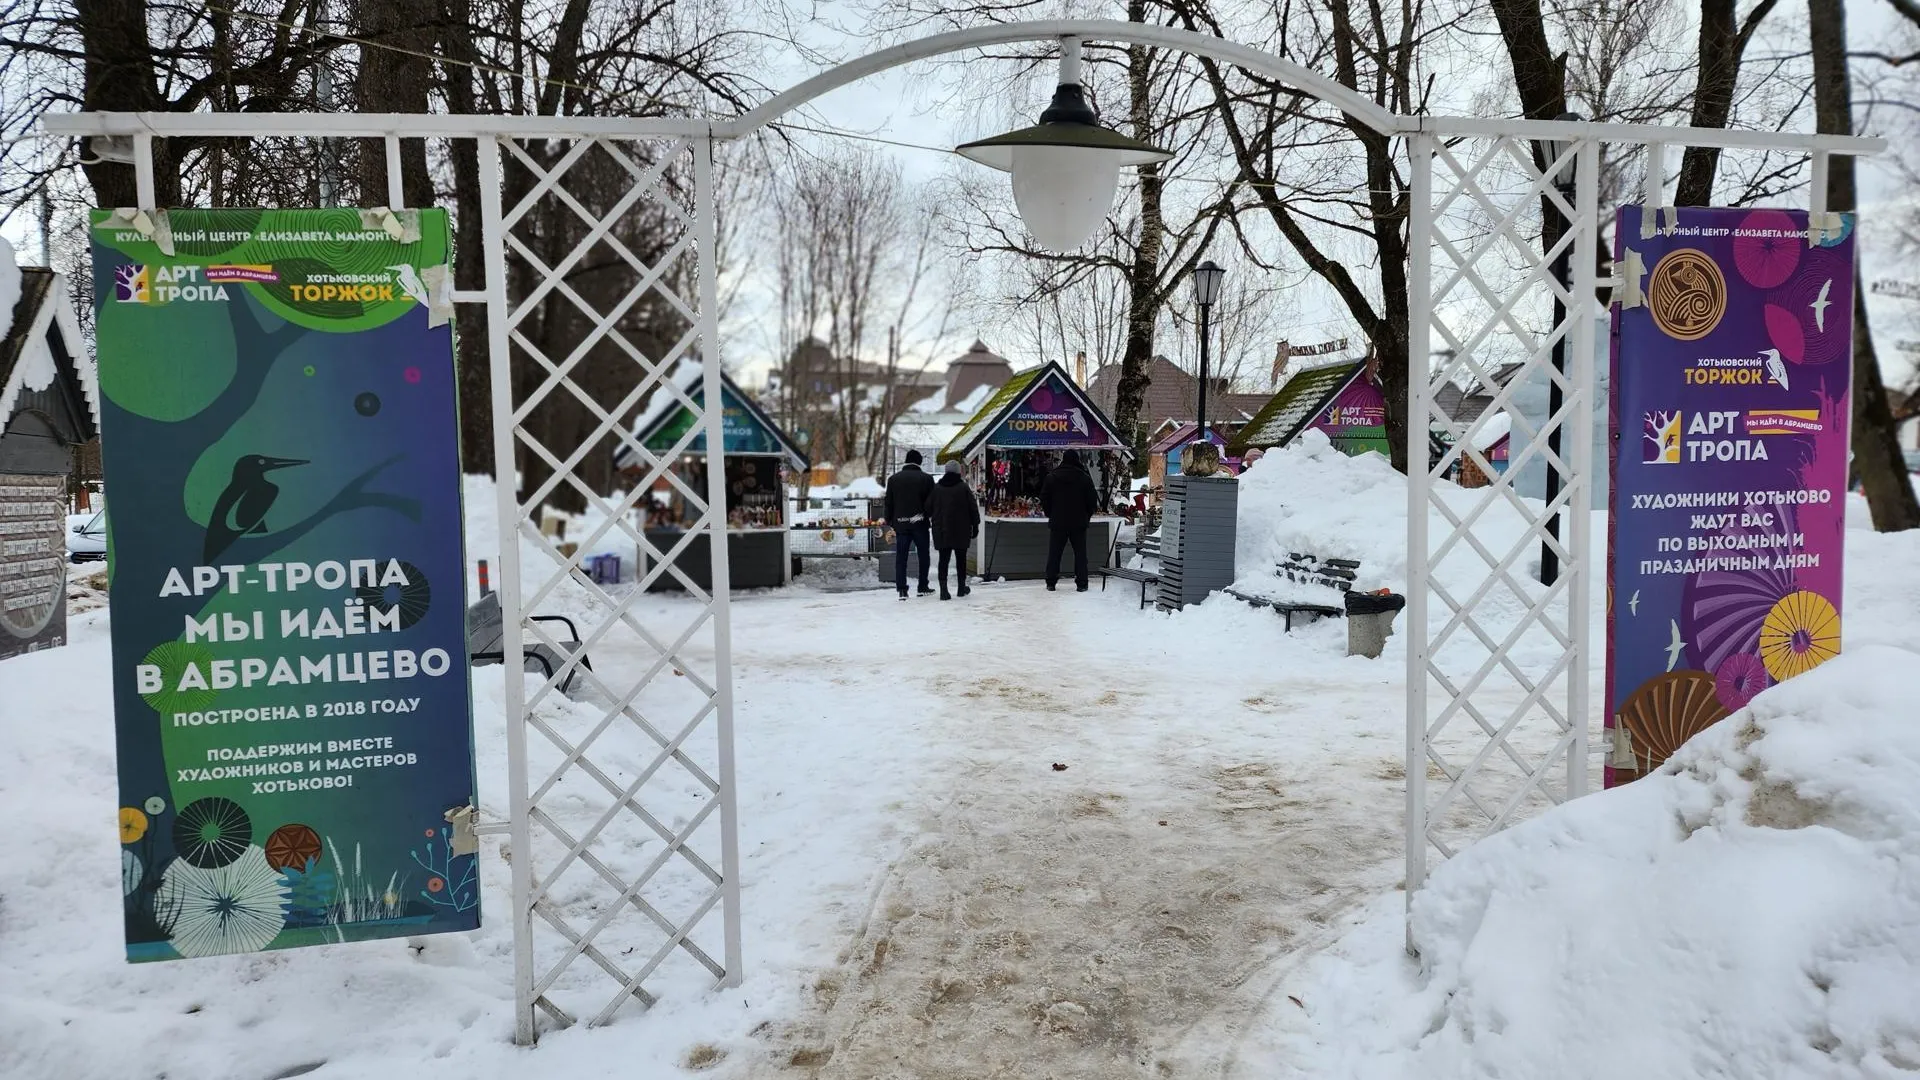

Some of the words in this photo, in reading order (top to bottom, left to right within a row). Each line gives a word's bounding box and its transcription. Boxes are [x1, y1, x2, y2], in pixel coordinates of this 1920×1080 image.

[115, 230, 205, 241] КУЛЬНЫЙ
[209, 231, 251, 242] ЦЕНТР
[255, 231, 333, 241] «ЕЛИЗАВЕТА
[1702, 228, 1730, 237] ЦЕНТР
[155, 265, 200, 283] АРТ
[219, 269, 236, 277] ИДЁМ
[306, 273, 392, 283] ХОТЬКОВСКИЙ
[155, 285, 230, 302] ТРОПА
[290, 285, 394, 302] ТОРЖОК
[1697, 357, 1762, 367] ХОТЬКОВСКИЙ
[1684, 368, 1763, 385] ТОРЖОК
[1017, 412, 1068, 420] ХОТЬКОВСКИЙ
[1341, 407, 1362, 415] АРТ
[1007, 420, 1068, 432] ТОРЖОК
[1340, 417, 1373, 426] ТРОПА
[1687, 411, 1740, 435] АРТ
[1759, 417, 1778, 426] ИДЁМ
[1784, 419, 1823, 431] АБРАМЦЕВО
[1687, 439, 1769, 462] ТРОПА
[1632, 491, 1739, 510] ХУДОЖНИКИ
[1743, 489, 1831, 506] ХОТЬКОВО
[1690, 513, 1736, 530] ЖДУТ
[1741, 512, 1774, 527] ВАС
[1658, 537, 1683, 552] ПО
[1687, 533, 1788, 551] ВЫХОДНЫМ
[1793, 533, 1804, 547] И
[1640, 555, 1770, 575] ПРАЗДНИЧНЫМ
[1774, 554, 1820, 570] ДНЯМ
[158, 557, 410, 598] АРТ-ТРОПА
[184, 610, 265, 644] МЫ
[280, 598, 401, 640] ИДЁМ
[136, 664, 163, 694] В
[176, 647, 451, 692] АБРАМЦЕВО
[173, 705, 300, 727] ПОСТРОЕНА
[305, 704, 317, 719] В
[323, 701, 366, 717] 2018
[372, 697, 421, 714] ГОДУ
[207, 741, 322, 762] ПОДДЕРЖИМ
[328, 736, 393, 753] ВМЕСТЕ
[176, 762, 304, 782] ХУДОЖНИКОВ
[309, 760, 321, 772] И
[326, 752, 417, 771] МАСТЕРОВ
[252, 774, 353, 794] ХОТЬКОВО!
